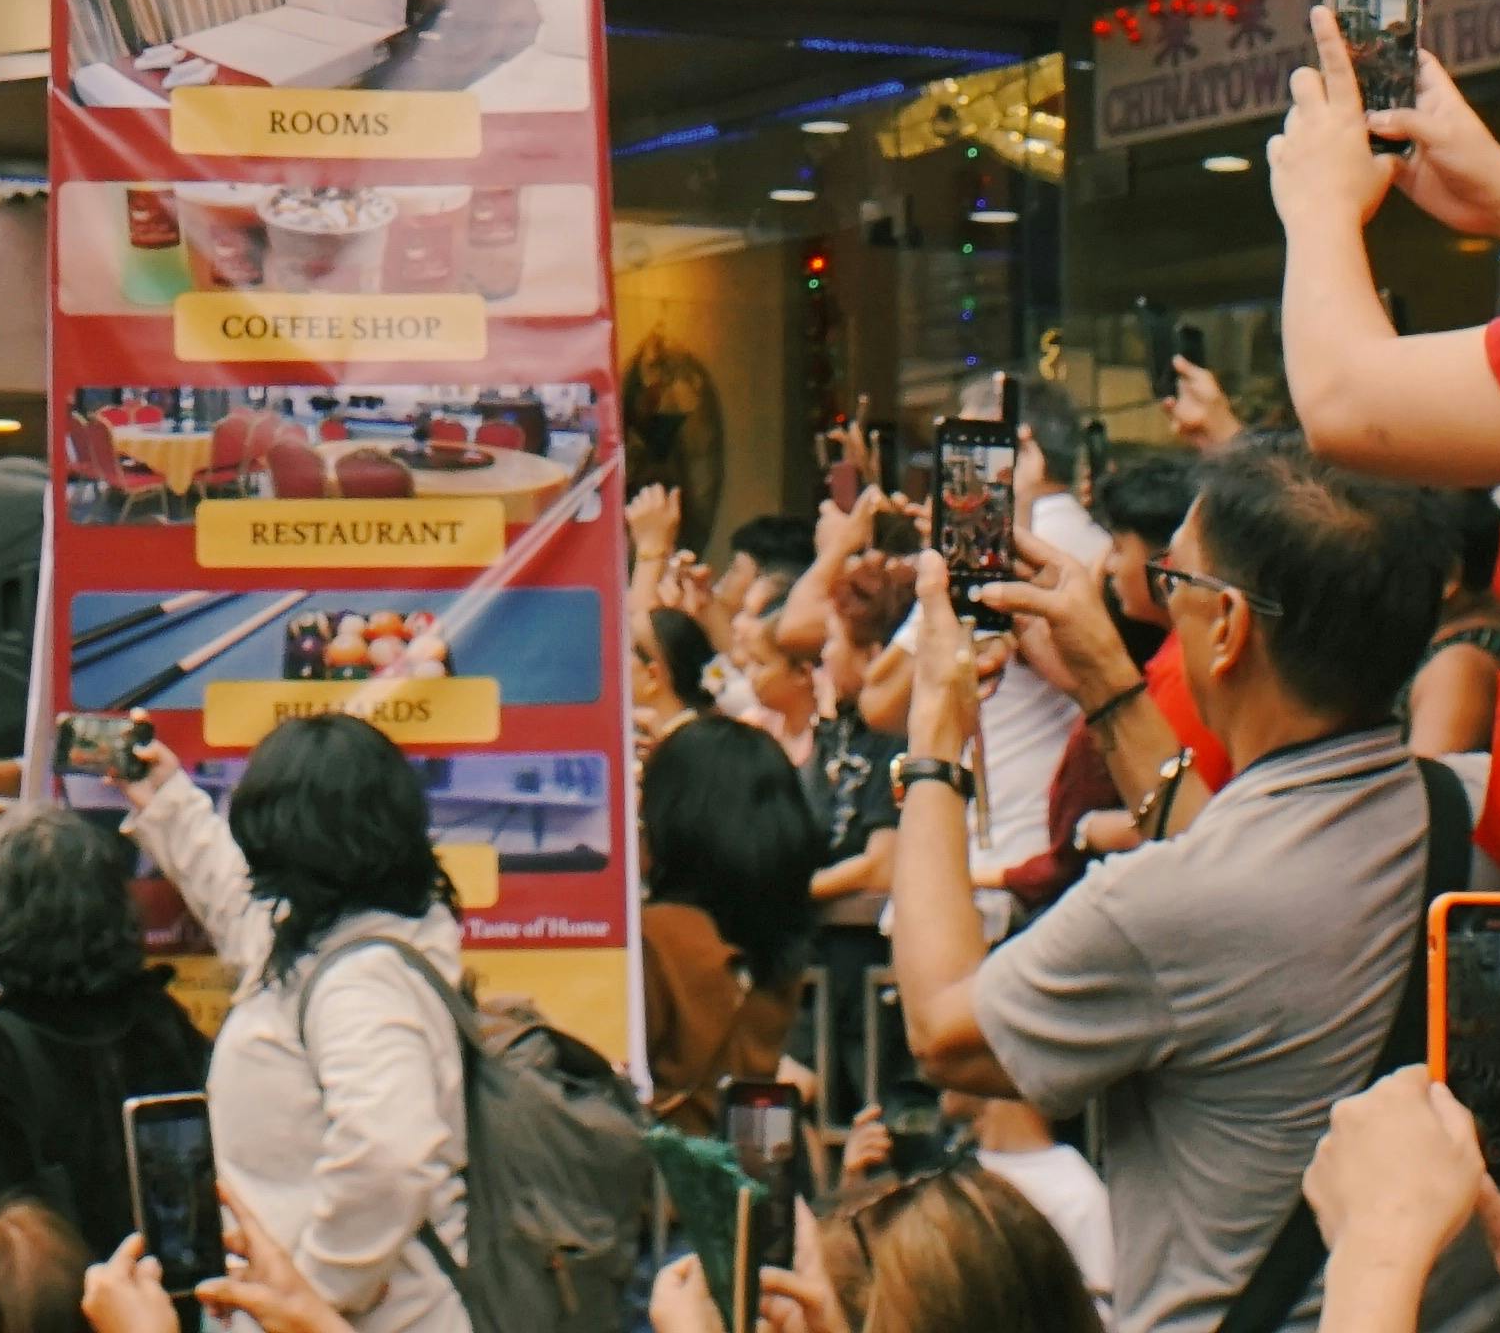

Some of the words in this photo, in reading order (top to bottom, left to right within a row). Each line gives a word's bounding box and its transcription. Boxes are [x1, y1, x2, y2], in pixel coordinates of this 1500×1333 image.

[269, 110, 390, 137] ROOMS
[220, 314, 344, 340] COFFEE
[352, 315, 441, 340] SHOP
[250, 520, 465, 547] RESTAURANT
